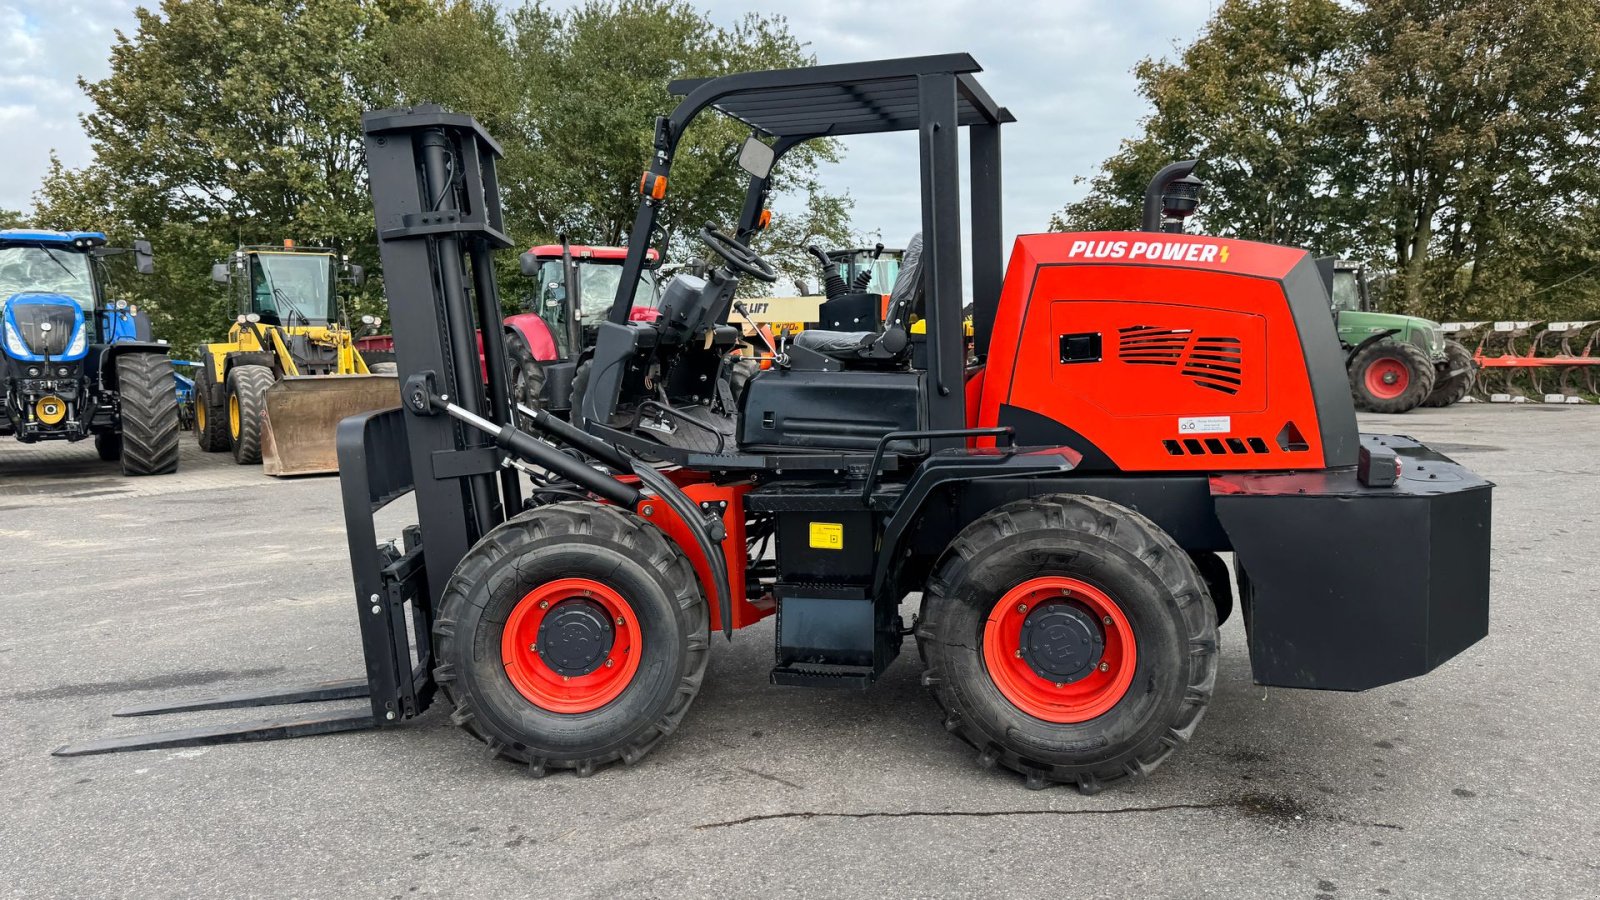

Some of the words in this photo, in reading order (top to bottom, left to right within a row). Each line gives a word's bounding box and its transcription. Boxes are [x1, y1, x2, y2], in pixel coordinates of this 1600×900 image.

[1068, 240, 1128, 258] PLUS
[1128, 241, 1219, 263] POWER
[749, 303, 769, 313] LIFT
